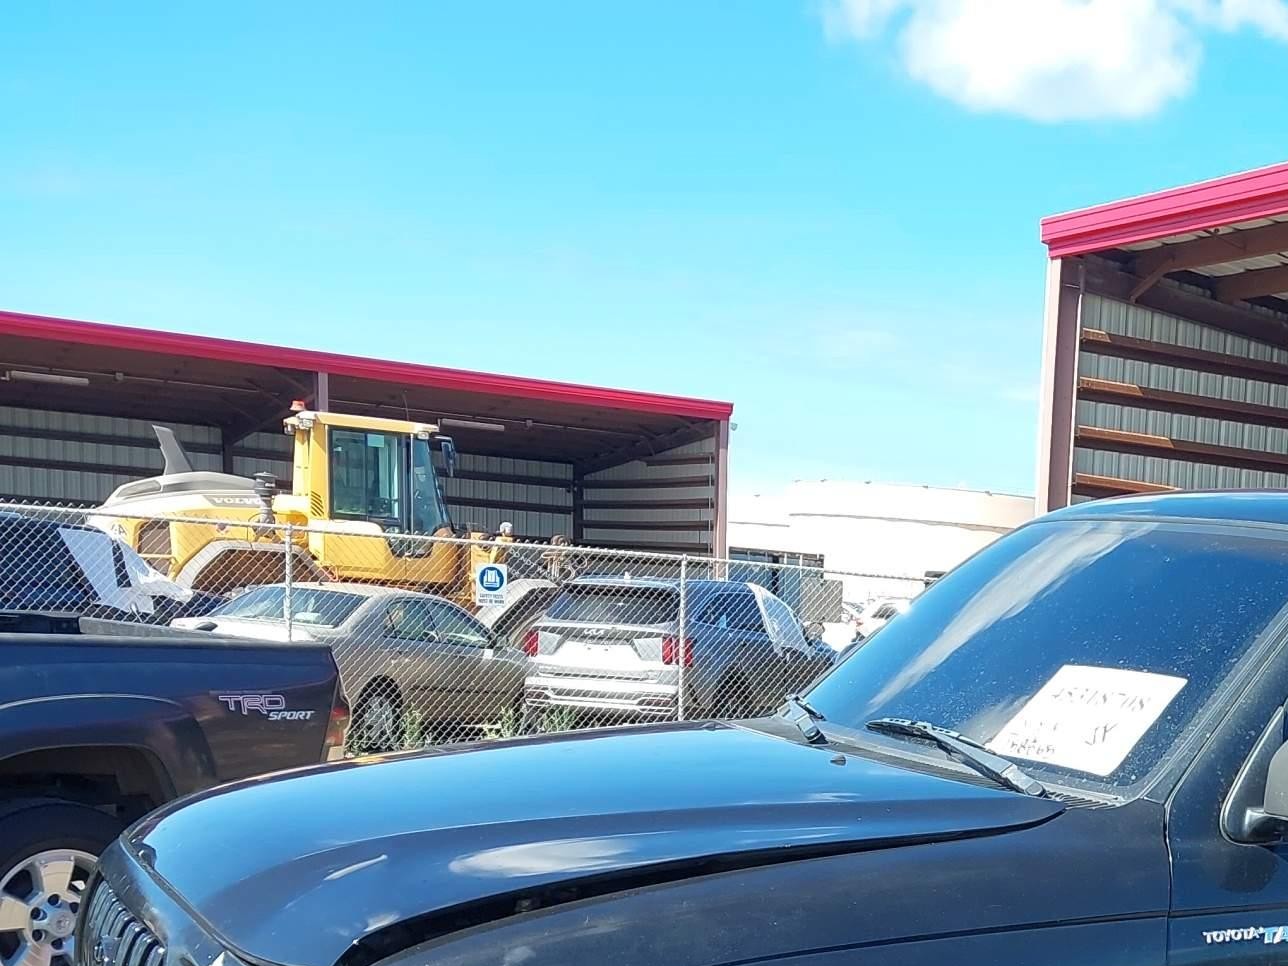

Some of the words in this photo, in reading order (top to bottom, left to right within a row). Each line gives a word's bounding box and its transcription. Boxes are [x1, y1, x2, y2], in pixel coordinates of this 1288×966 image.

[212, 497, 262, 505] VOLVO
[219, 694, 285, 715] TRD
[267, 710, 316, 720] SPORT
[1203, 926, 1261, 944] TOYOTA
